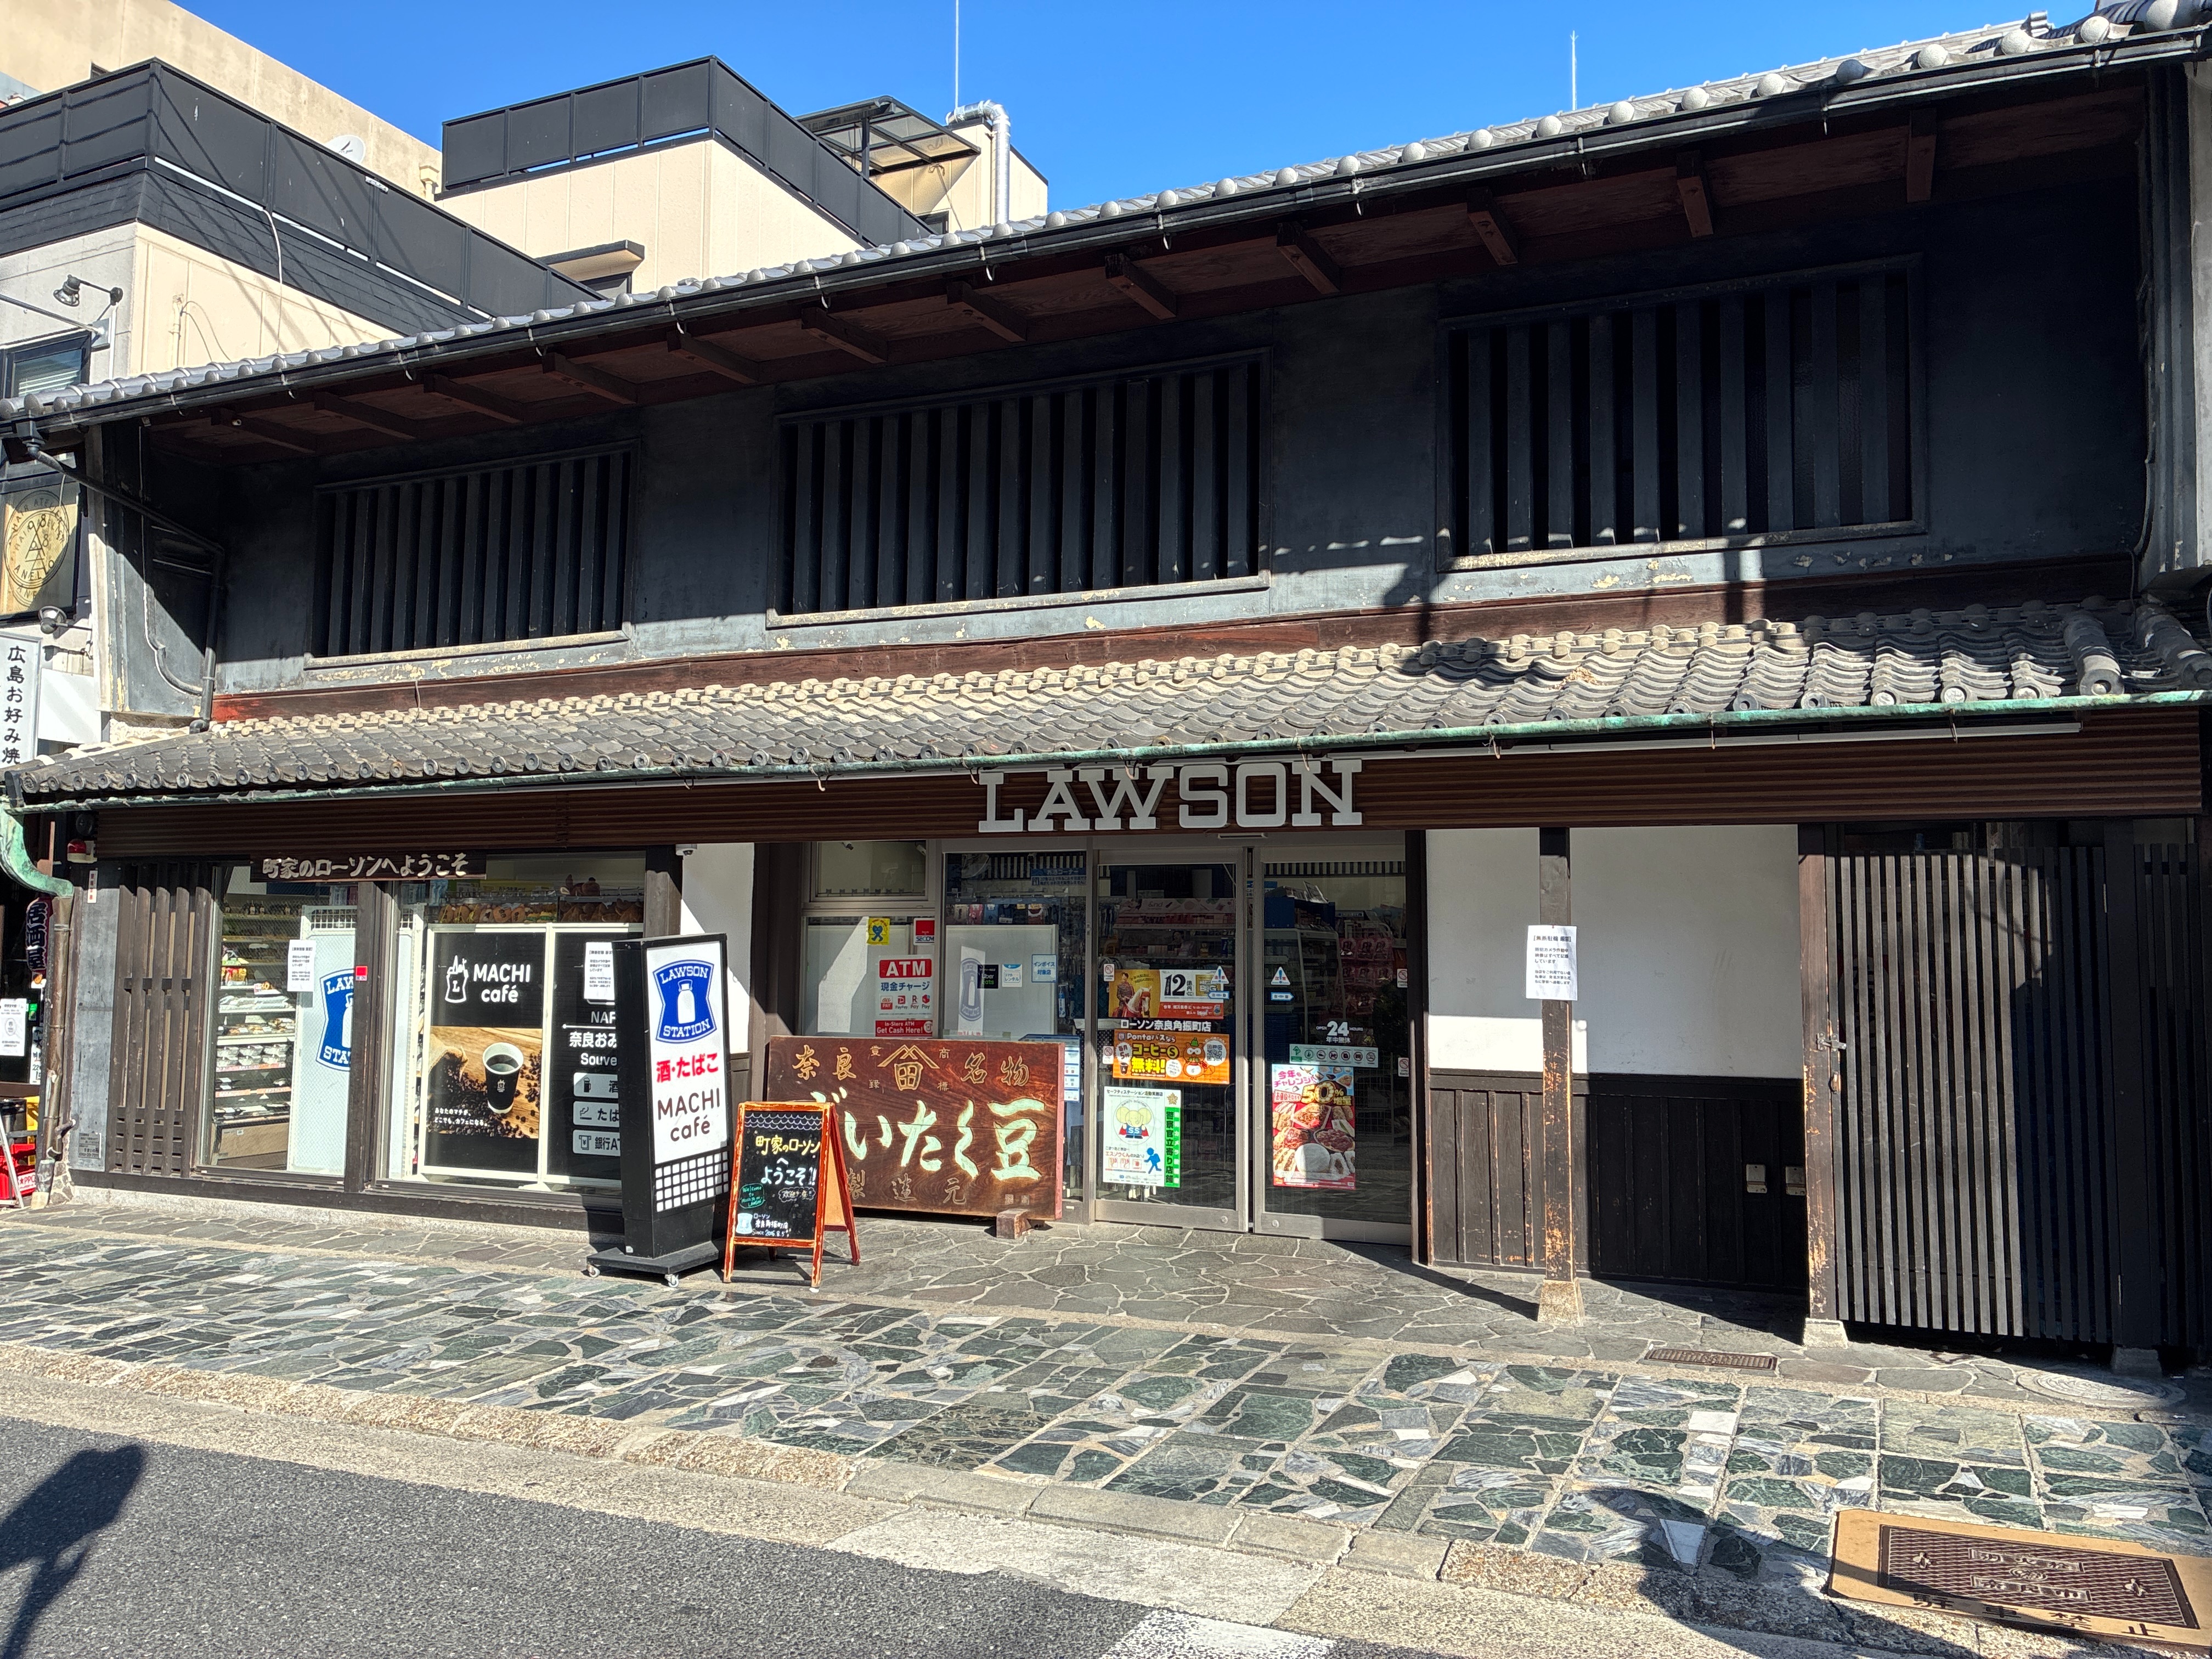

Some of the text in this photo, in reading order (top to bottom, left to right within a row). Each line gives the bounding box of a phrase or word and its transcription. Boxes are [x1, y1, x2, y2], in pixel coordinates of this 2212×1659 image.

[11, 505, 29, 530] HAIR
[2, 646, 26, 765] 広島お好み焼
[978, 759, 1362, 832] LAWSON
[262, 852, 469, 879] 町家のローソンへようこそ
[473, 964, 531, 983] MACHI
[660, 965, 709, 984] LAWSON
[885, 961, 926, 977] ATM
[481, 985, 518, 1003] café
[881, 981, 930, 992] 現金チャージ
[1164, 974, 1186, 996] 12
[663, 1018, 711, 1038] STATION
[1121, 1020, 1211, 1032] ローソン奈良角振町店
[1327, 1020, 1349, 1036] 24
[580, 1053, 617, 1066] Souve
[656, 1053, 719, 1083] 酒・たばこ
[792, 1044, 857, 1081] 奈良
[961, 1052, 1030, 1087] 名物
[657, 1087, 721, 1120] MACHI
[670, 1114, 711, 1142] café
[755, 1135, 821, 1155] 町家のローソン
[1912, 1592, 2166, 1639] 駐車禁止
